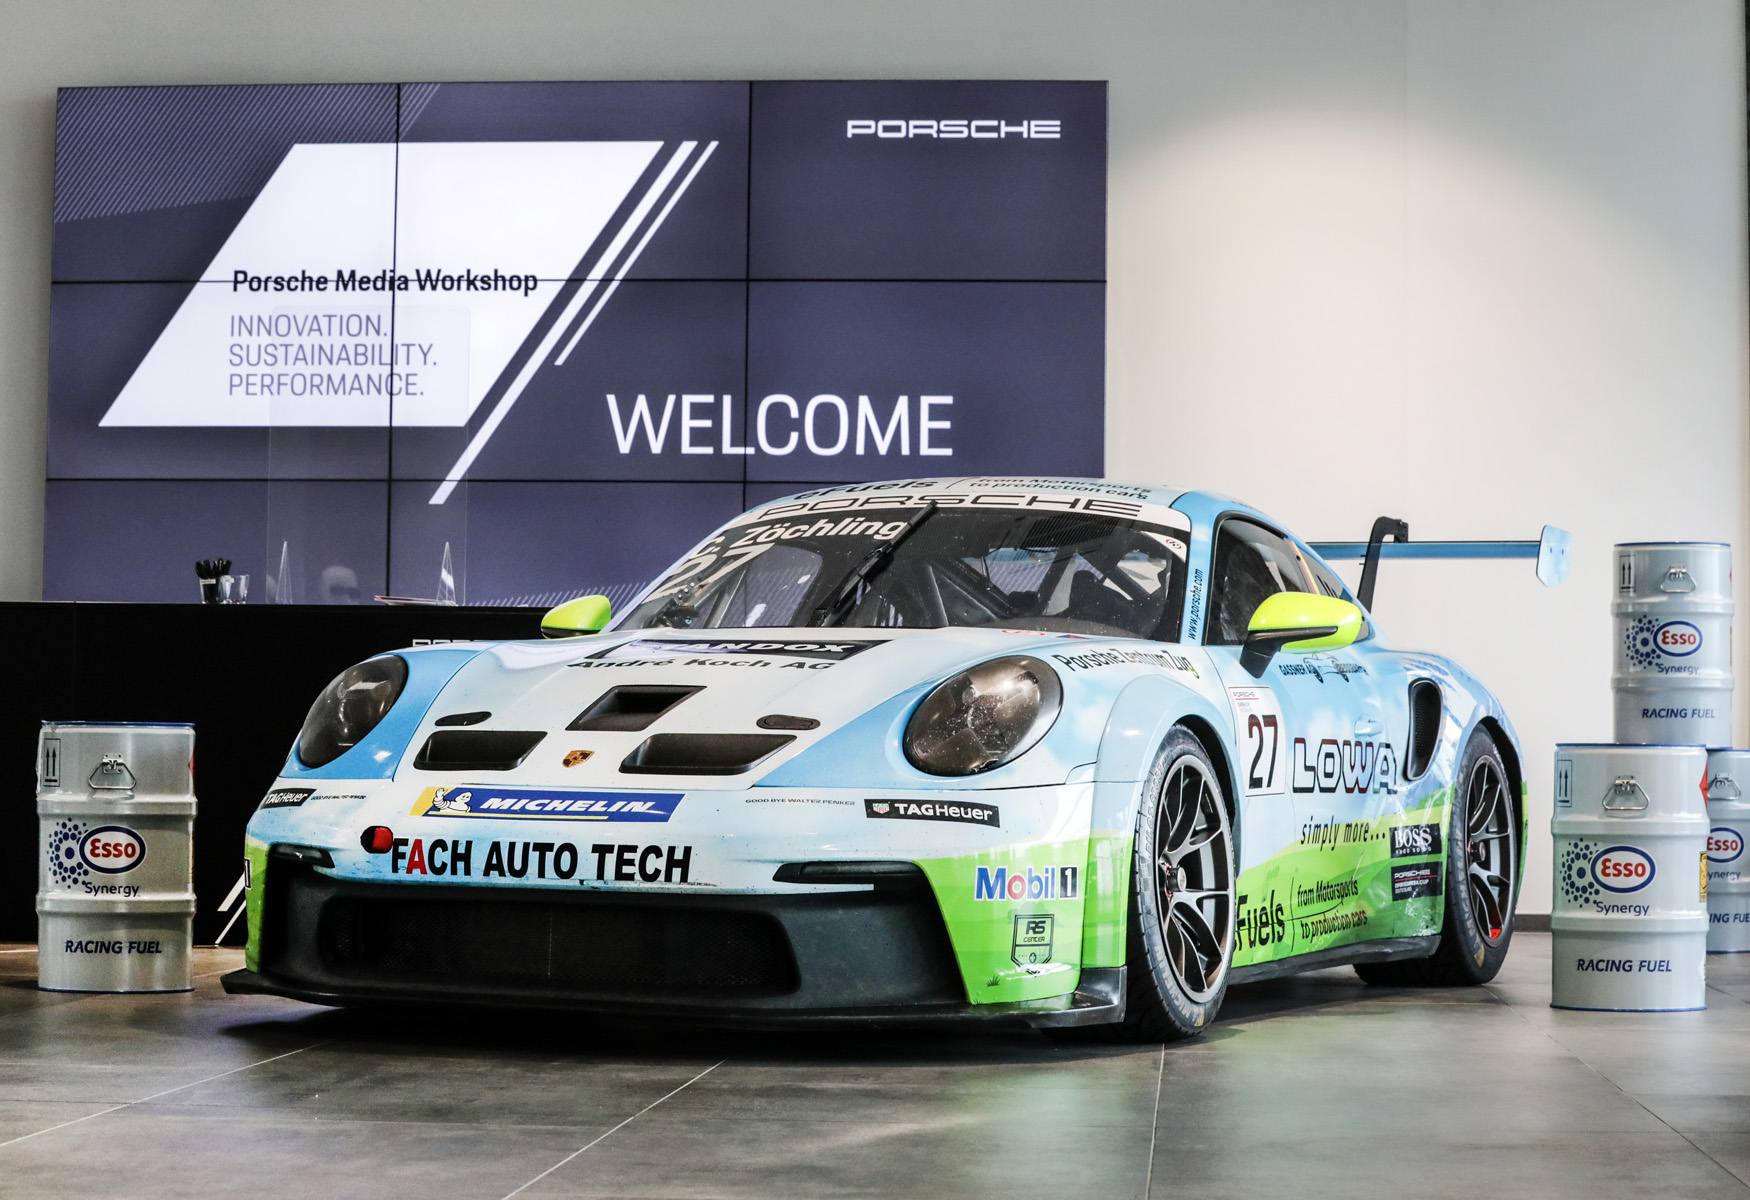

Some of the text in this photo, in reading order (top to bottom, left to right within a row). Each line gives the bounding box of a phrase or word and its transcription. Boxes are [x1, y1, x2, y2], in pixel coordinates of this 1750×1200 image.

[846, 119, 1062, 139] PORSCHE
[232, 268, 539, 297] Porsche Media Workshop
[230, 313, 388, 338] INNOVATION.
[228, 343, 438, 367] SUSTAINABILITY.
[228, 372, 425, 397] PERFORMANCE.
[605, 393, 954, 457] WELCOME
[757, 493, 1143, 520] PORSCHE
[729, 517, 909, 549] Zöchling
[1187, 568, 1204, 641] www.porsche.com
[1661, 629, 1697, 646] Esso
[566, 658, 837, 670] André Koch AG
[1657, 663, 1700, 675] Synergy
[1641, 708, 1716, 719] RACING FUEL
[1247, 713, 1279, 790] 27
[1292, 737, 1398, 795] LOWA
[480, 797, 662, 814] MICHELIN
[1300, 815, 1341, 852] simply
[1394, 827, 1433, 849] BOSS
[89, 838, 137, 859] Esso
[391, 837, 693, 883] FACH AUTO TECH
[1600, 858, 1646, 878] Esso
[975, 866, 1056, 900] Mobil
[1706, 869, 1741, 881] ynergy
[85, 882, 140, 898] Synergy
[1297, 884, 1315, 908] from
[1595, 900, 1650, 917] Synergy
[1709, 912, 1731, 924] ING
[1025, 920, 1047, 935] RS
[1234, 889, 1286, 953] Fuels
[1300, 919, 1310, 940] to
[65, 939, 163, 954] RACING FUEL
[1576, 958, 1673, 973] RACING FUEL
